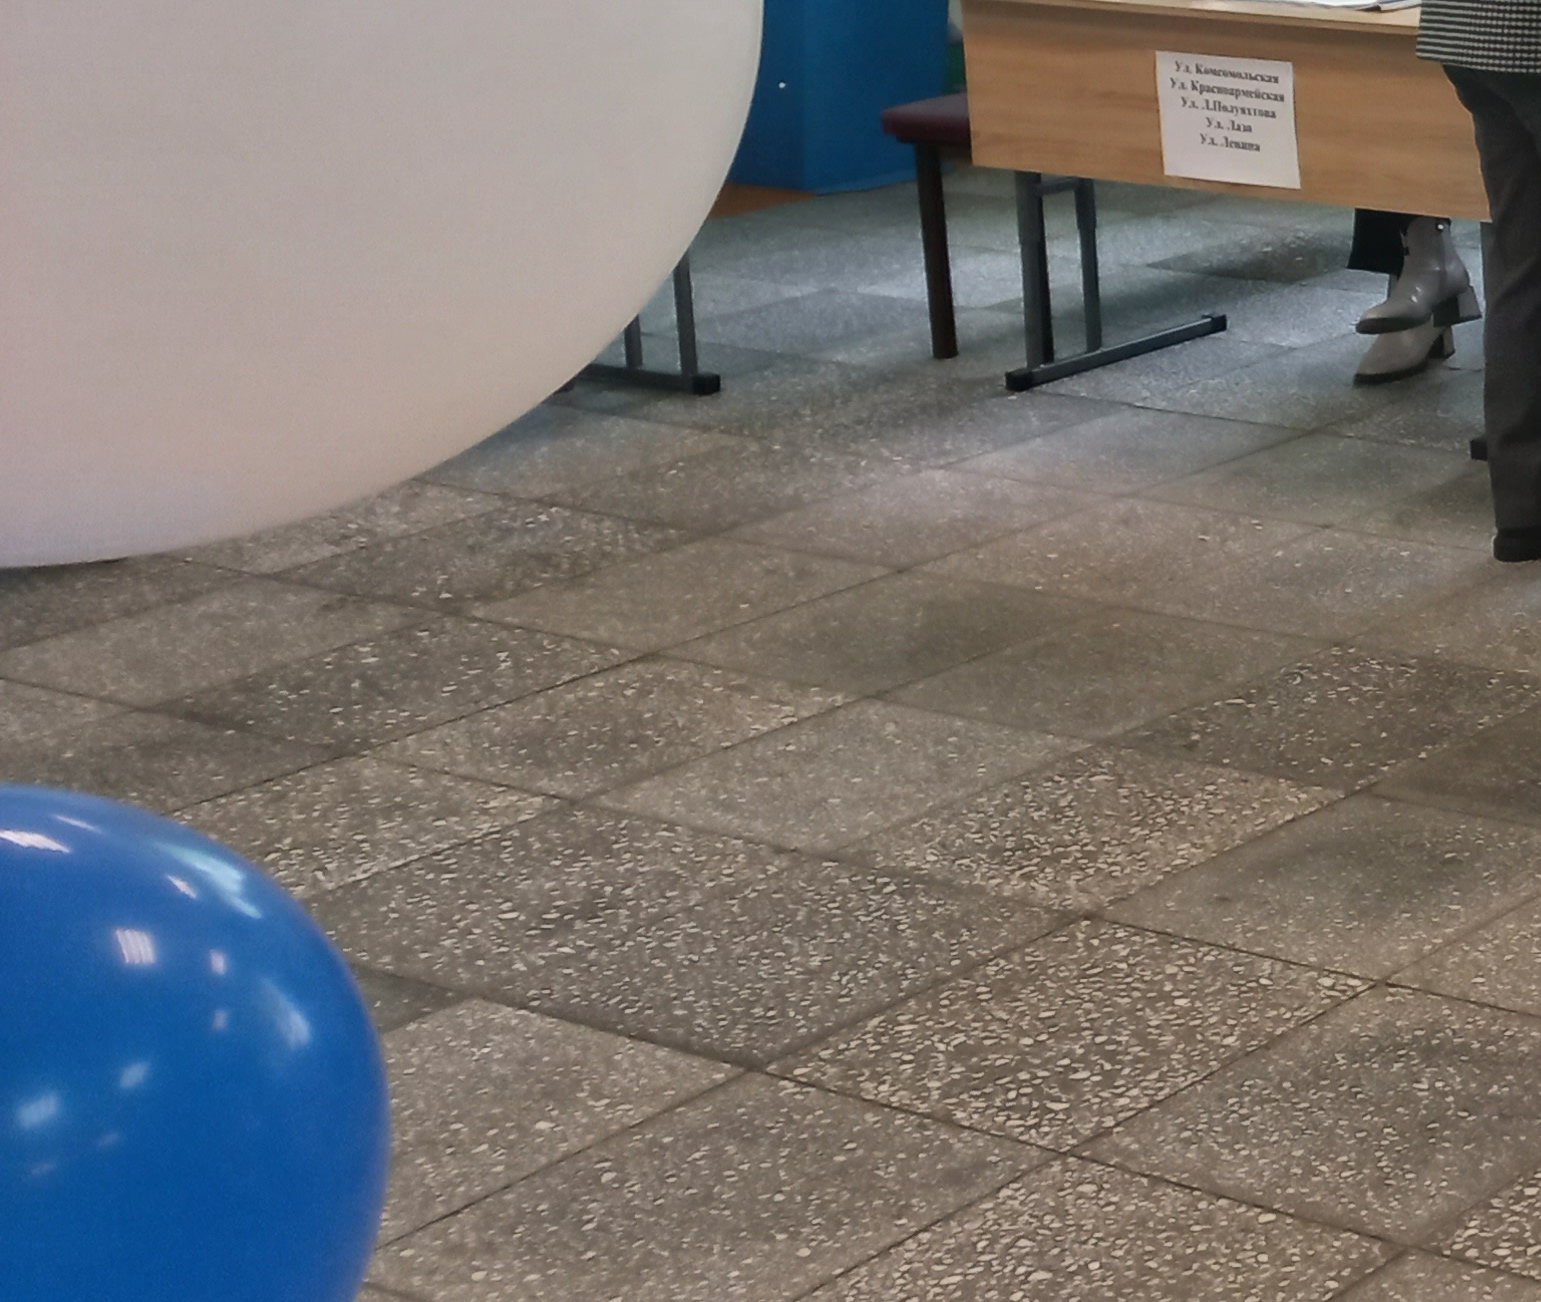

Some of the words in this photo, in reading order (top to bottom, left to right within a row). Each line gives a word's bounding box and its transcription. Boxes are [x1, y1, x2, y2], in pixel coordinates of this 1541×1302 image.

[1175, 60, 1192, 74] Ул.
[1195, 63, 1279, 84] Комсомольская
[1170, 77, 1187, 90] Ул.
[1191, 80, 1285, 102] Красноармейская
[1181, 96, 1199, 109] Ул.
[1206, 117, 1224, 130] Ул.
[1200, 133, 1218, 146] Ул.
[1220, 136, 1260, 152] Ленина
